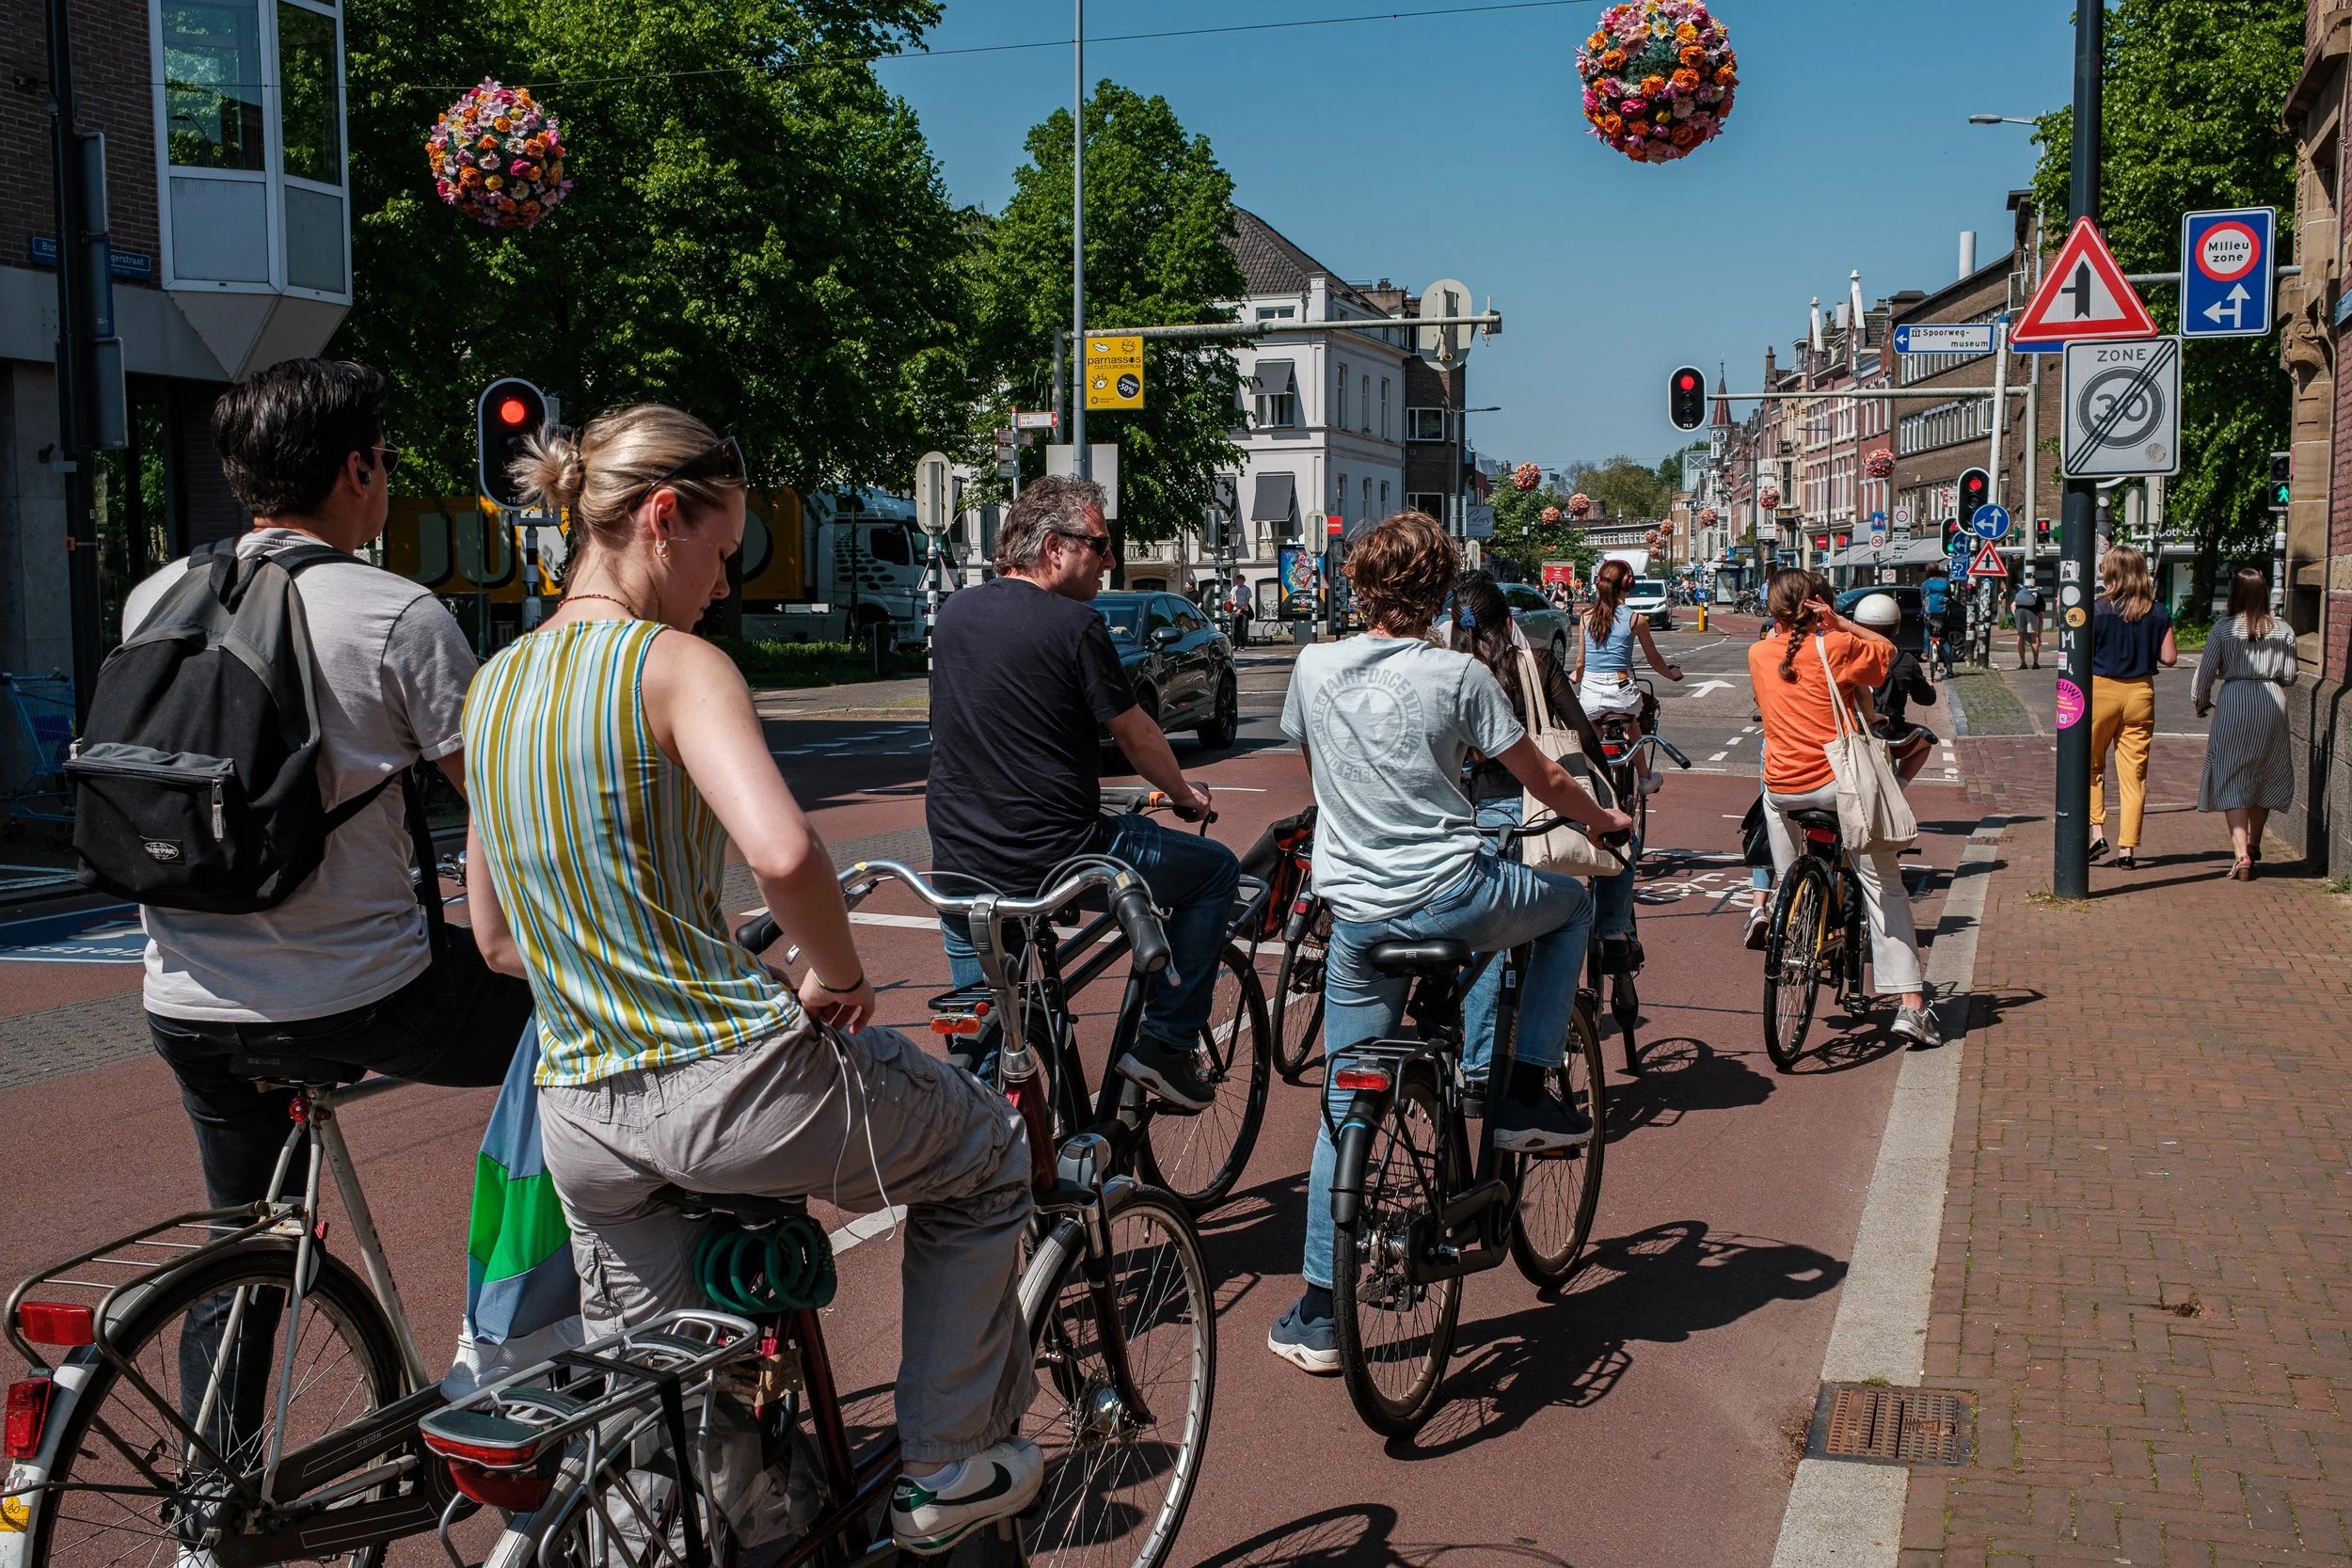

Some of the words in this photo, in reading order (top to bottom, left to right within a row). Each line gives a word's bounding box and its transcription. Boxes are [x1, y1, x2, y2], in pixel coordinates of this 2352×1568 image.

[2208, 241, 2249, 251] Milieu
[2213, 254, 2244, 262] zone
[1923, 328, 1970, 338] Spoorweg-
[2097, 349, 2147, 362] ZONE
[1118, 383, 1135, 395] -50%
[2093, 393, 2148, 422] 30
[1326, 667, 1411, 696] AIRFORCE
[357, 1432, 382, 1448] UNION
